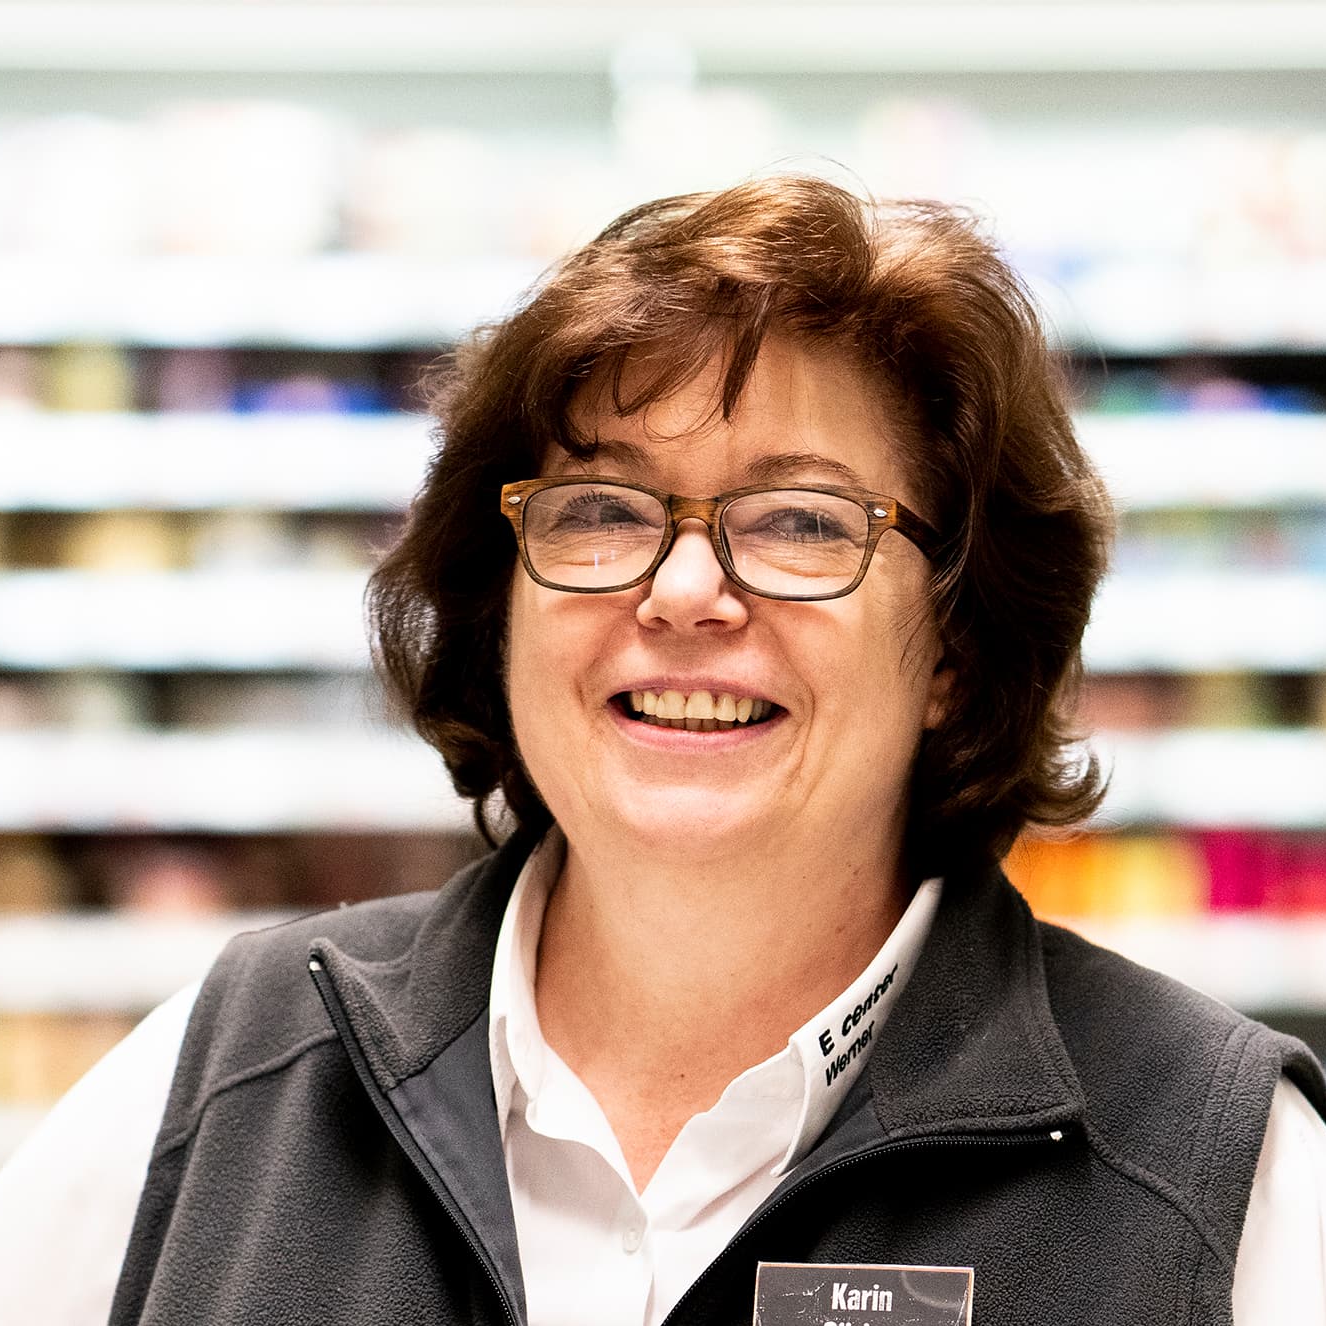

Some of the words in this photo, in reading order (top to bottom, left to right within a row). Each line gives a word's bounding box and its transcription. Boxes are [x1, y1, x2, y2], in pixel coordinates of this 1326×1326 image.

[818, 1028, 835, 1057] E
[825, 1020, 875, 1087] Werner
[831, 1282, 893, 1312] Karin
